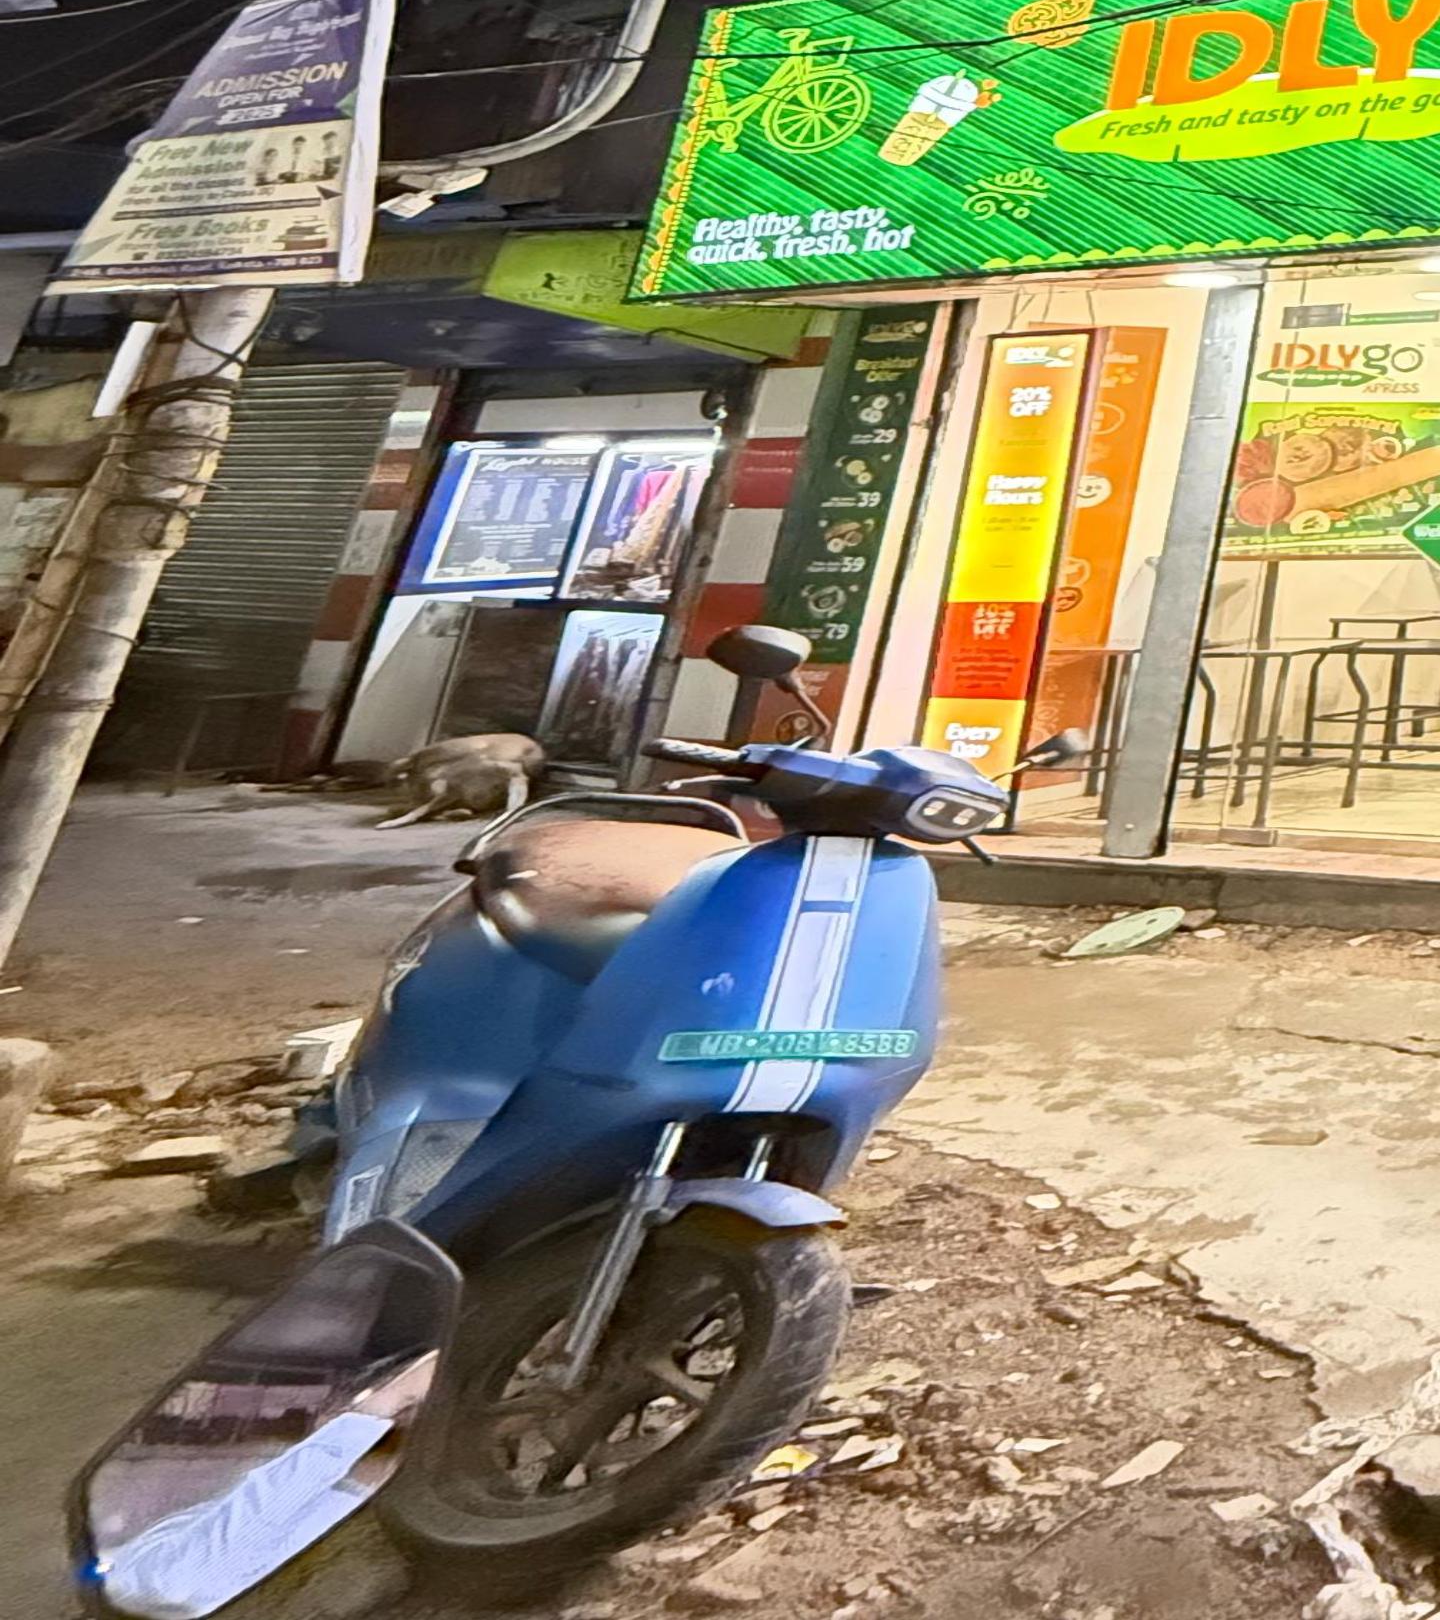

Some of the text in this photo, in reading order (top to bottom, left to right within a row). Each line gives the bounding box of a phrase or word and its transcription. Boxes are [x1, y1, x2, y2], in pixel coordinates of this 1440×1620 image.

[192, 61, 348, 98] ADMISSION
[217, 90, 263, 108] OPEN
[1100, 113, 1171, 140] Fresh
[1179, 109, 1232, 132] and
[1237, 102, 1306, 129] tasty
[1316, 100, 1350, 118] on
[1359, 92, 1406, 113] the
[863, 225, 915, 251] hot
[1010, 386, 1052, 402] 20%
[1009, 401, 1051, 417] OFF
[873, 428, 897, 443] 29
[857, 491, 882, 507] 39
[841, 556, 866, 573] 59
[825, 623, 850, 640] 79
[945, 722, 1003, 741] Every
